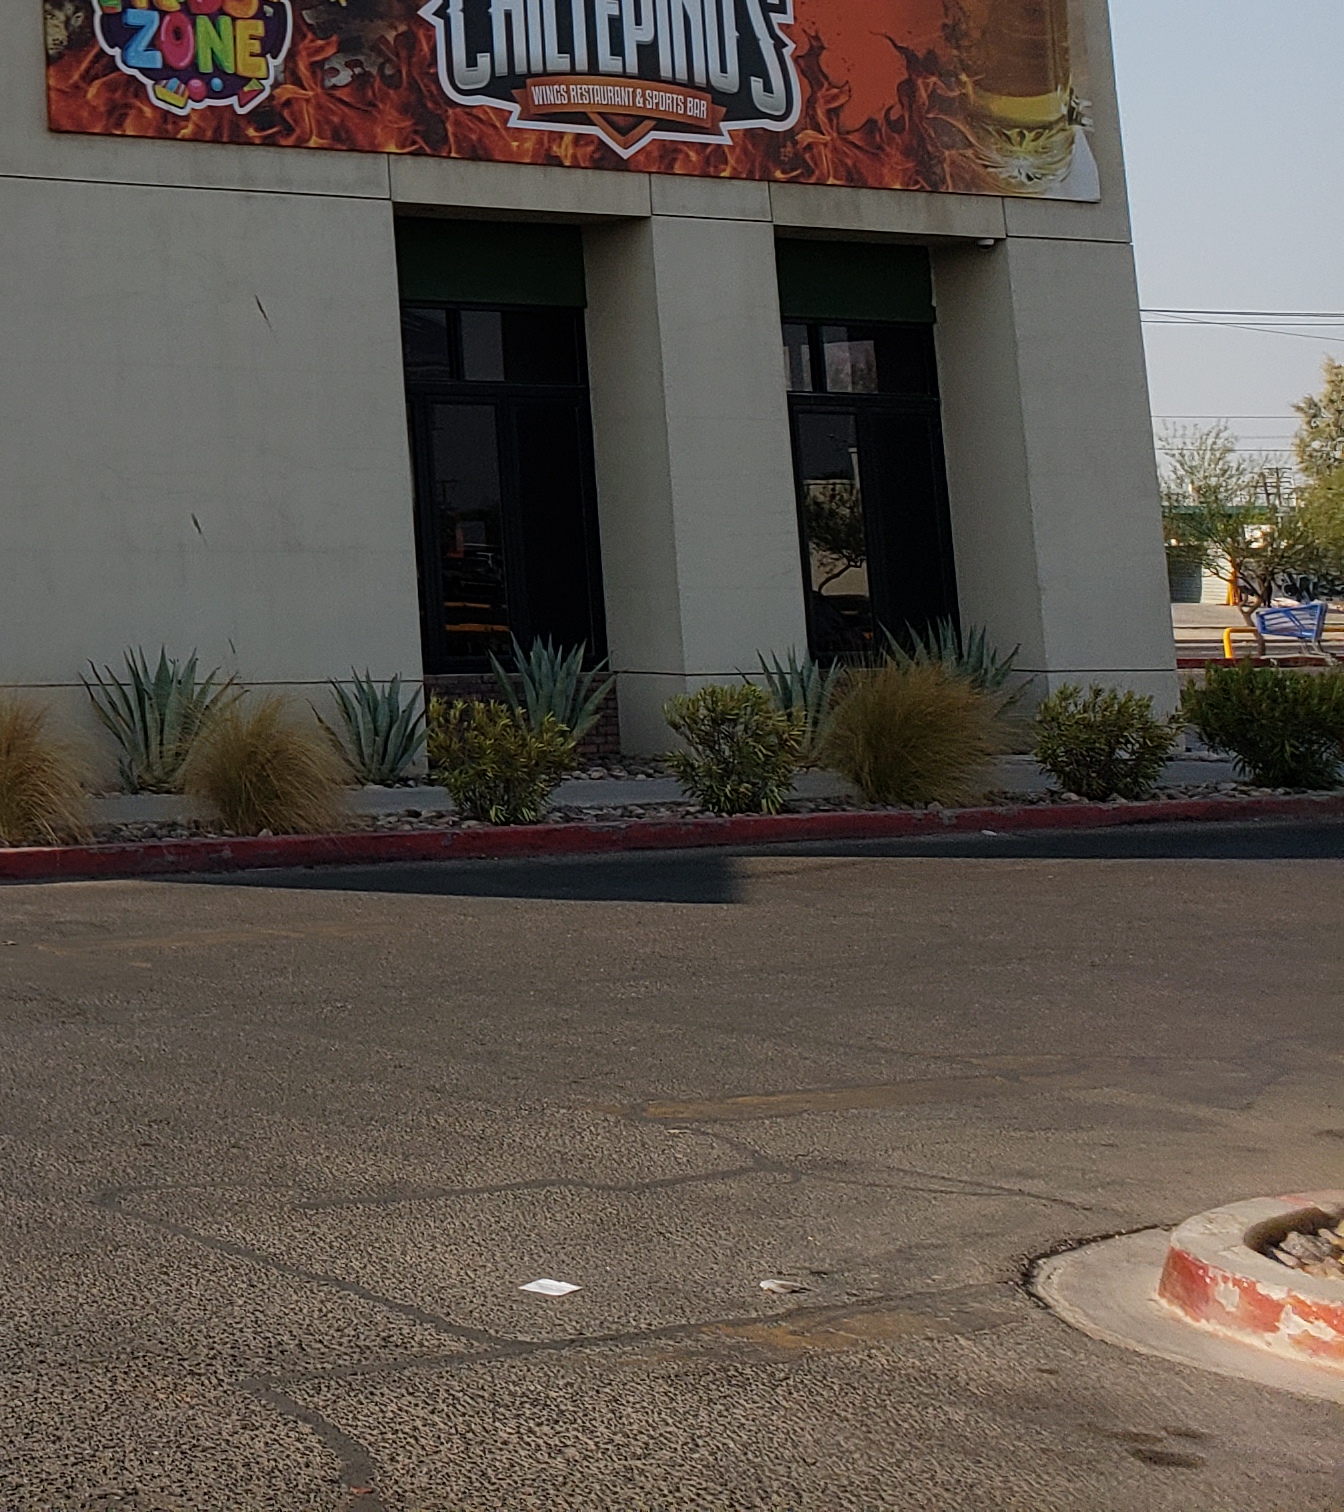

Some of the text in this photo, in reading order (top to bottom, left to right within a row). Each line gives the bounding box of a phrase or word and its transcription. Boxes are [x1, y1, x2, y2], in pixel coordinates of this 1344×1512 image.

[122, 8, 269, 79] ZONE
[531, 83, 708, 120] WINGS RESTAURANT & SPORTS BAR
